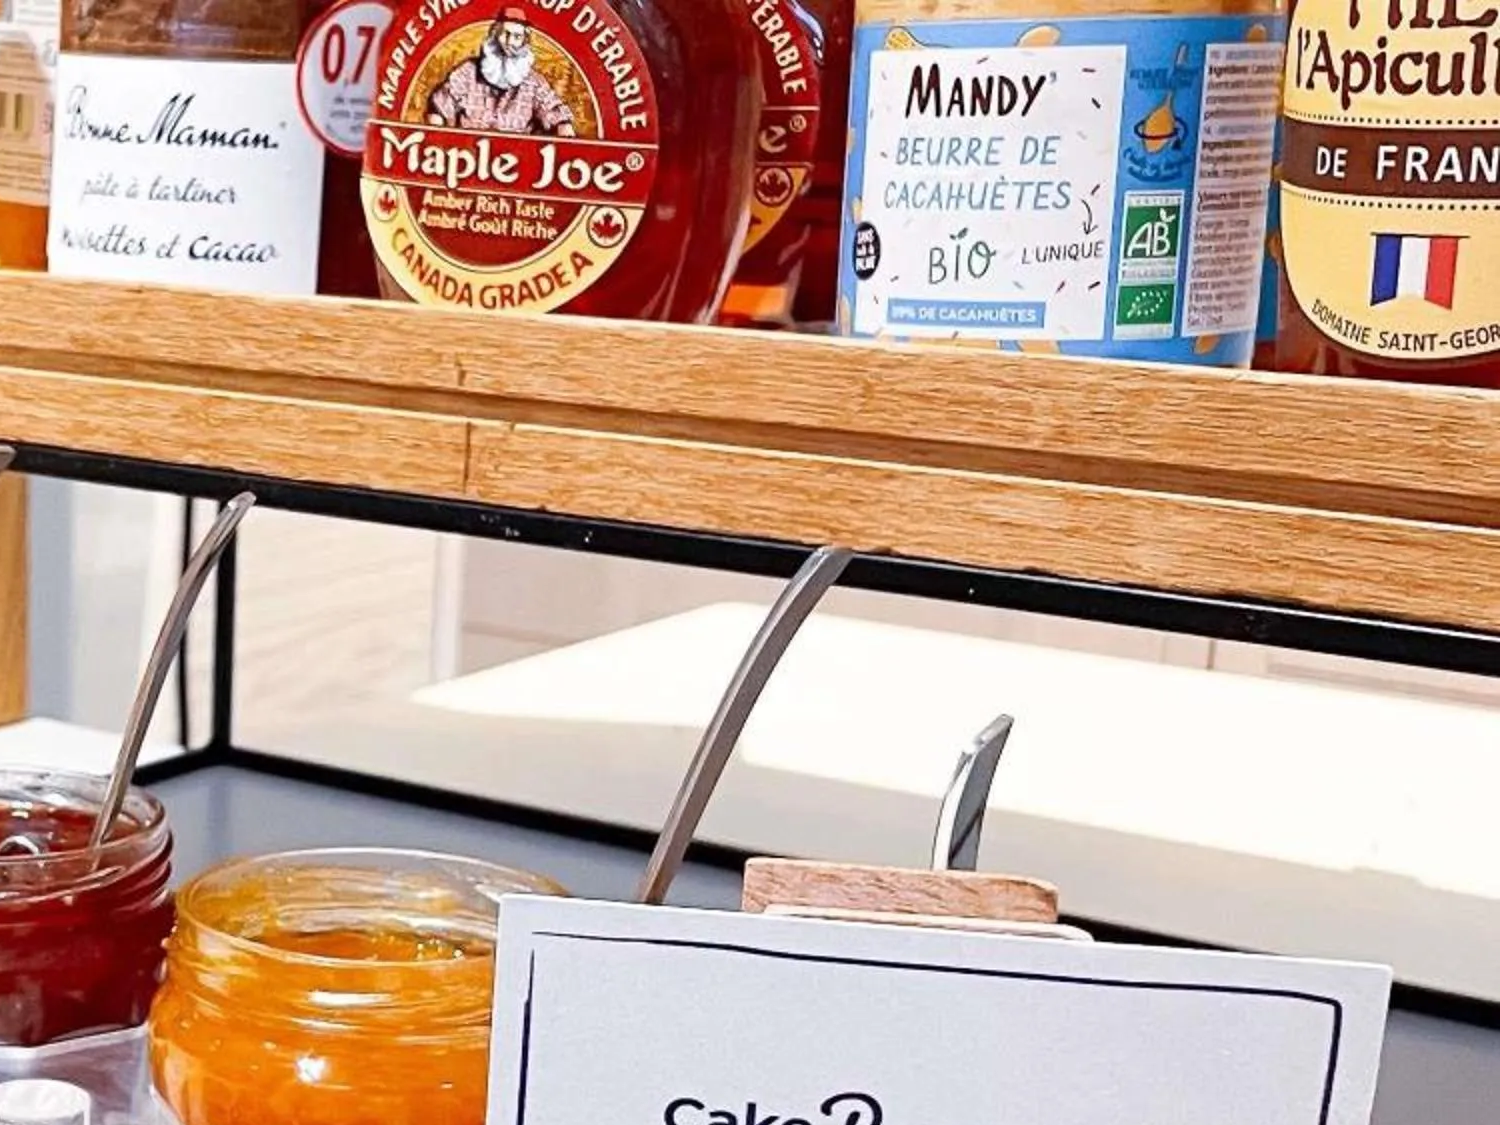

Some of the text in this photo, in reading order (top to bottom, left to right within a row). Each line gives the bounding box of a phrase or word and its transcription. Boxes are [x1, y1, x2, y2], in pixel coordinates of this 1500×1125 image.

[378, 19, 423, 111] MAPLE
[572, 5, 648, 131] D'ÉRABLE
[1296, 27, 1500, 110] l'Apicul
[136, 92, 280, 150] Maman
[380, 127, 519, 189] Maple
[895, 135, 1062, 166] BEURRE DE
[1315, 146, 1348, 178] DE
[422, 190, 555, 221] Amber Rich Taste
[884, 175, 1072, 212] CACAHUÈTES
[416, 209, 467, 231] Ambré
[512, 220, 559, 242] Riche
[1126, 220, 1172, 258] AB
[156, 232, 181, 259] et
[188, 235, 277, 262] Cacao
[391, 228, 595, 310] CANADA GRADE A
[1311, 298, 1373, 345] DOMAINE
